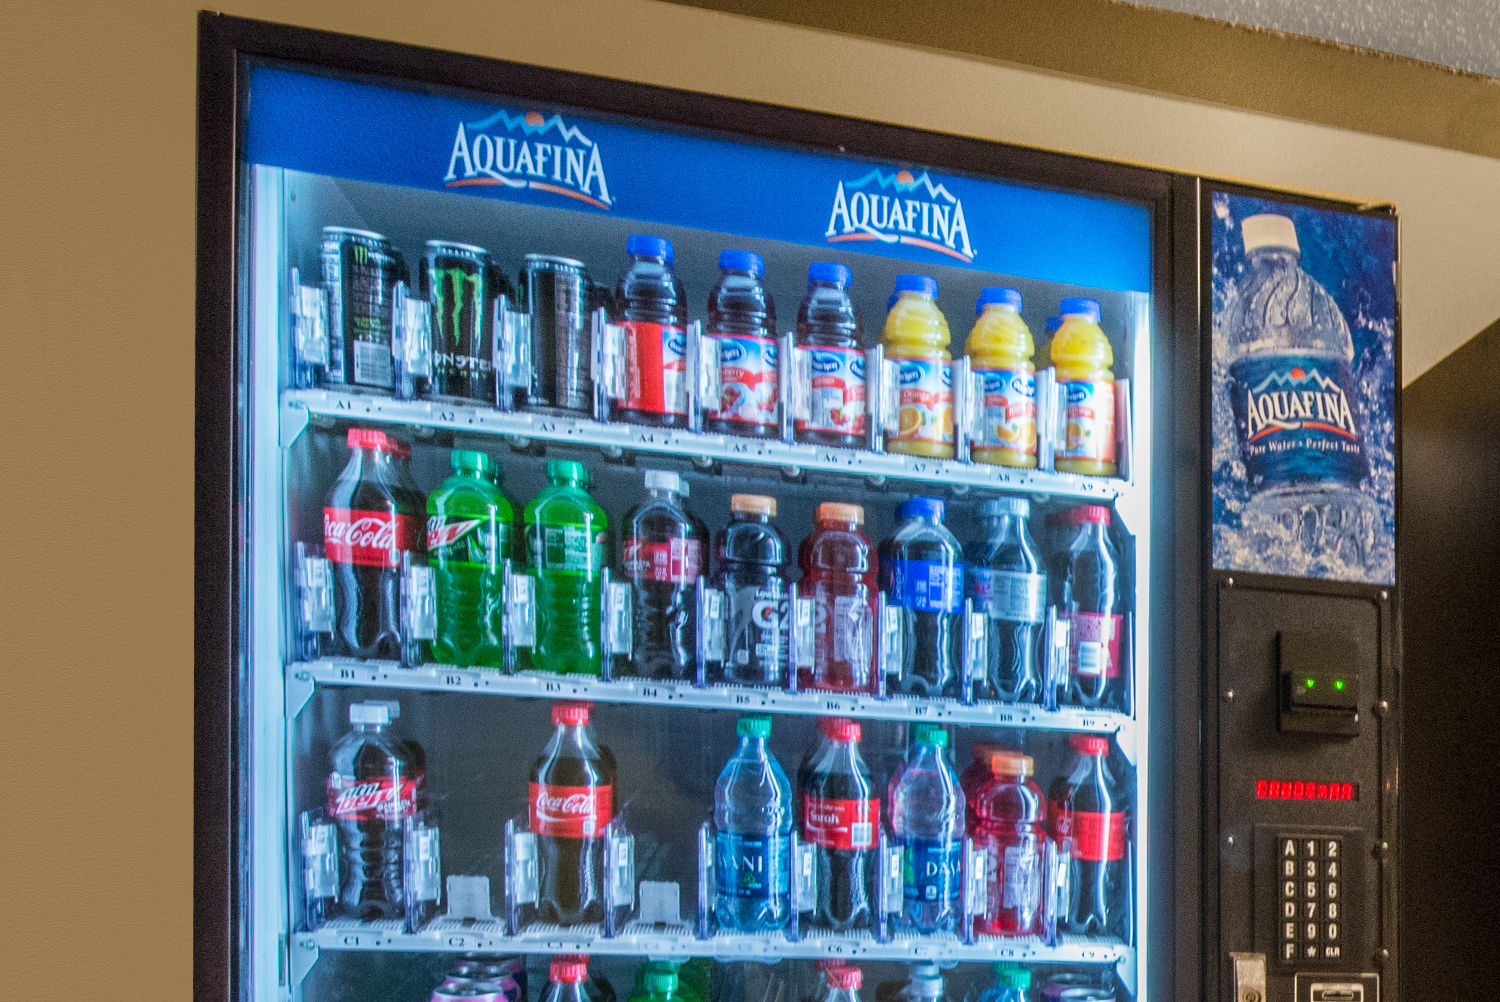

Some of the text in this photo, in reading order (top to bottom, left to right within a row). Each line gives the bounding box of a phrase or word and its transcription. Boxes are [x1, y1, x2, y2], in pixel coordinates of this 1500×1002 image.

[444, 121, 613, 203] AQUAFINA
[826, 179, 972, 257] AQUAFINA
[439, 412, 455, 421] A2
[1247, 389, 1357, 439] AQUAFINA
[638, 434, 654, 442] A4
[733, 444, 747, 453] A5
[1268, 440, 1296, 452] Water
[1306, 438, 1339, 452] Perfect
[824, 454, 838, 463] A6
[912, 464, 926, 472] A7
[997, 473, 1010, 482] A8
[1080, 483, 1093, 491] A9
[341, 669, 356, 678] B1
[446, 676, 461, 685] B2
[546, 682, 560, 691] B3
[643, 689, 657, 698] B4
[736, 696, 750, 705] B5
[826, 702, 840, 711] B6
[915, 706, 928, 715] B7
[1000, 713, 1013, 722] B8
[1082, 718, 1095, 727] B9
[1285, 840, 1337, 857] A 1 2
[1285, 861, 1337, 878] B 3 4
[1285, 882, 1337, 898] C 5 6
[1285, 902, 1337, 919] D 7 8
[1285, 923, 1337, 940] E 9 0
[344, 936, 360, 946] C1
[449, 936, 465, 947] C2
[1000, 949, 1013, 957] C8
[1286, 944, 1294, 959] F
